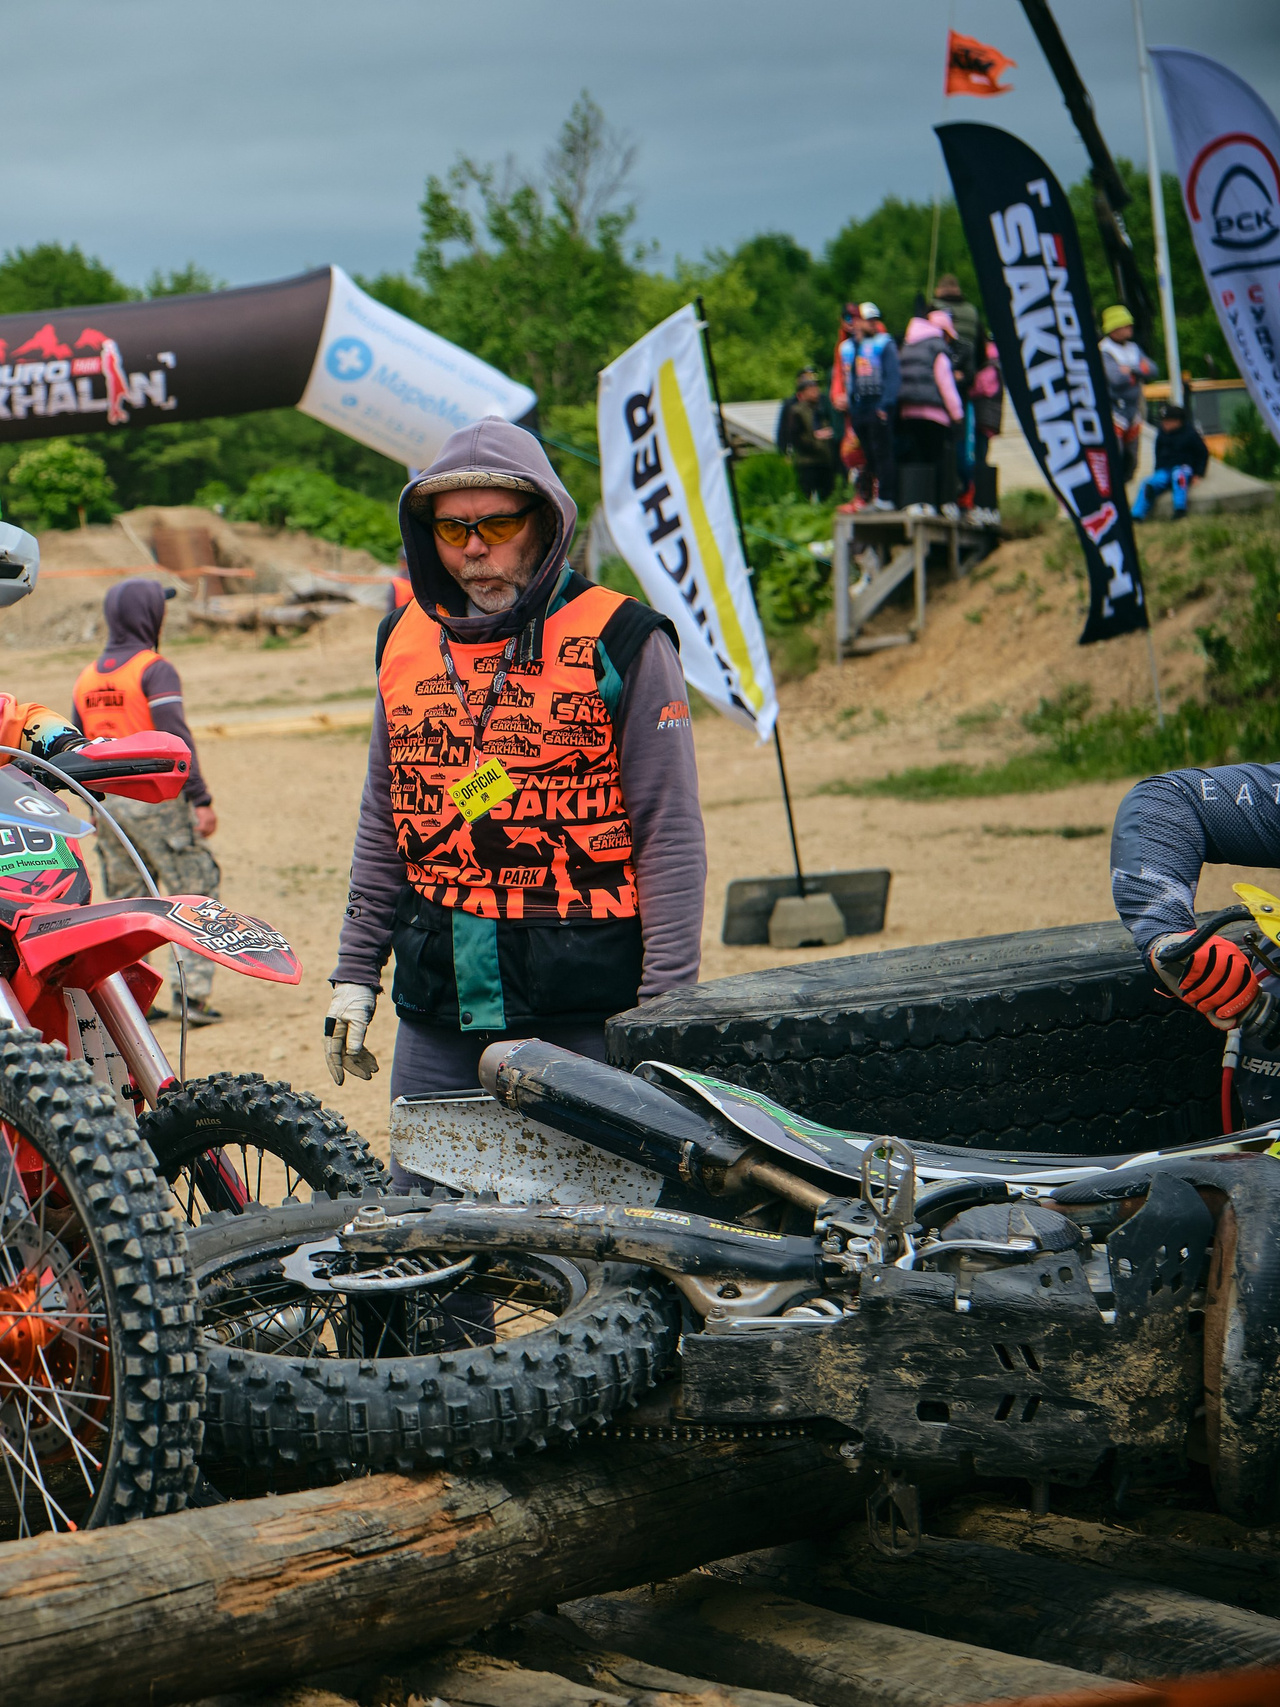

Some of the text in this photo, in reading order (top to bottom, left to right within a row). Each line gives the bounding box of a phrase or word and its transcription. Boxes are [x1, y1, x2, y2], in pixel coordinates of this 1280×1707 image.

[1040, 232, 1104, 446] ENDURO
[659, 701, 689, 721] KTM
[492, 722, 540, 733] SAKHALIN
[545, 734, 604, 746] SAKHALIN
[483, 745, 538, 756] SAKHALIN
[461, 768, 501, 799] OFFICIAL
[489, 786, 626, 820] SAKHA
[593, 836, 632, 850] SAKHAL
[16, 858, 59, 868] Николай
[503, 869, 541, 884] PARK
[708, 1222, 783, 1240] HINSON
